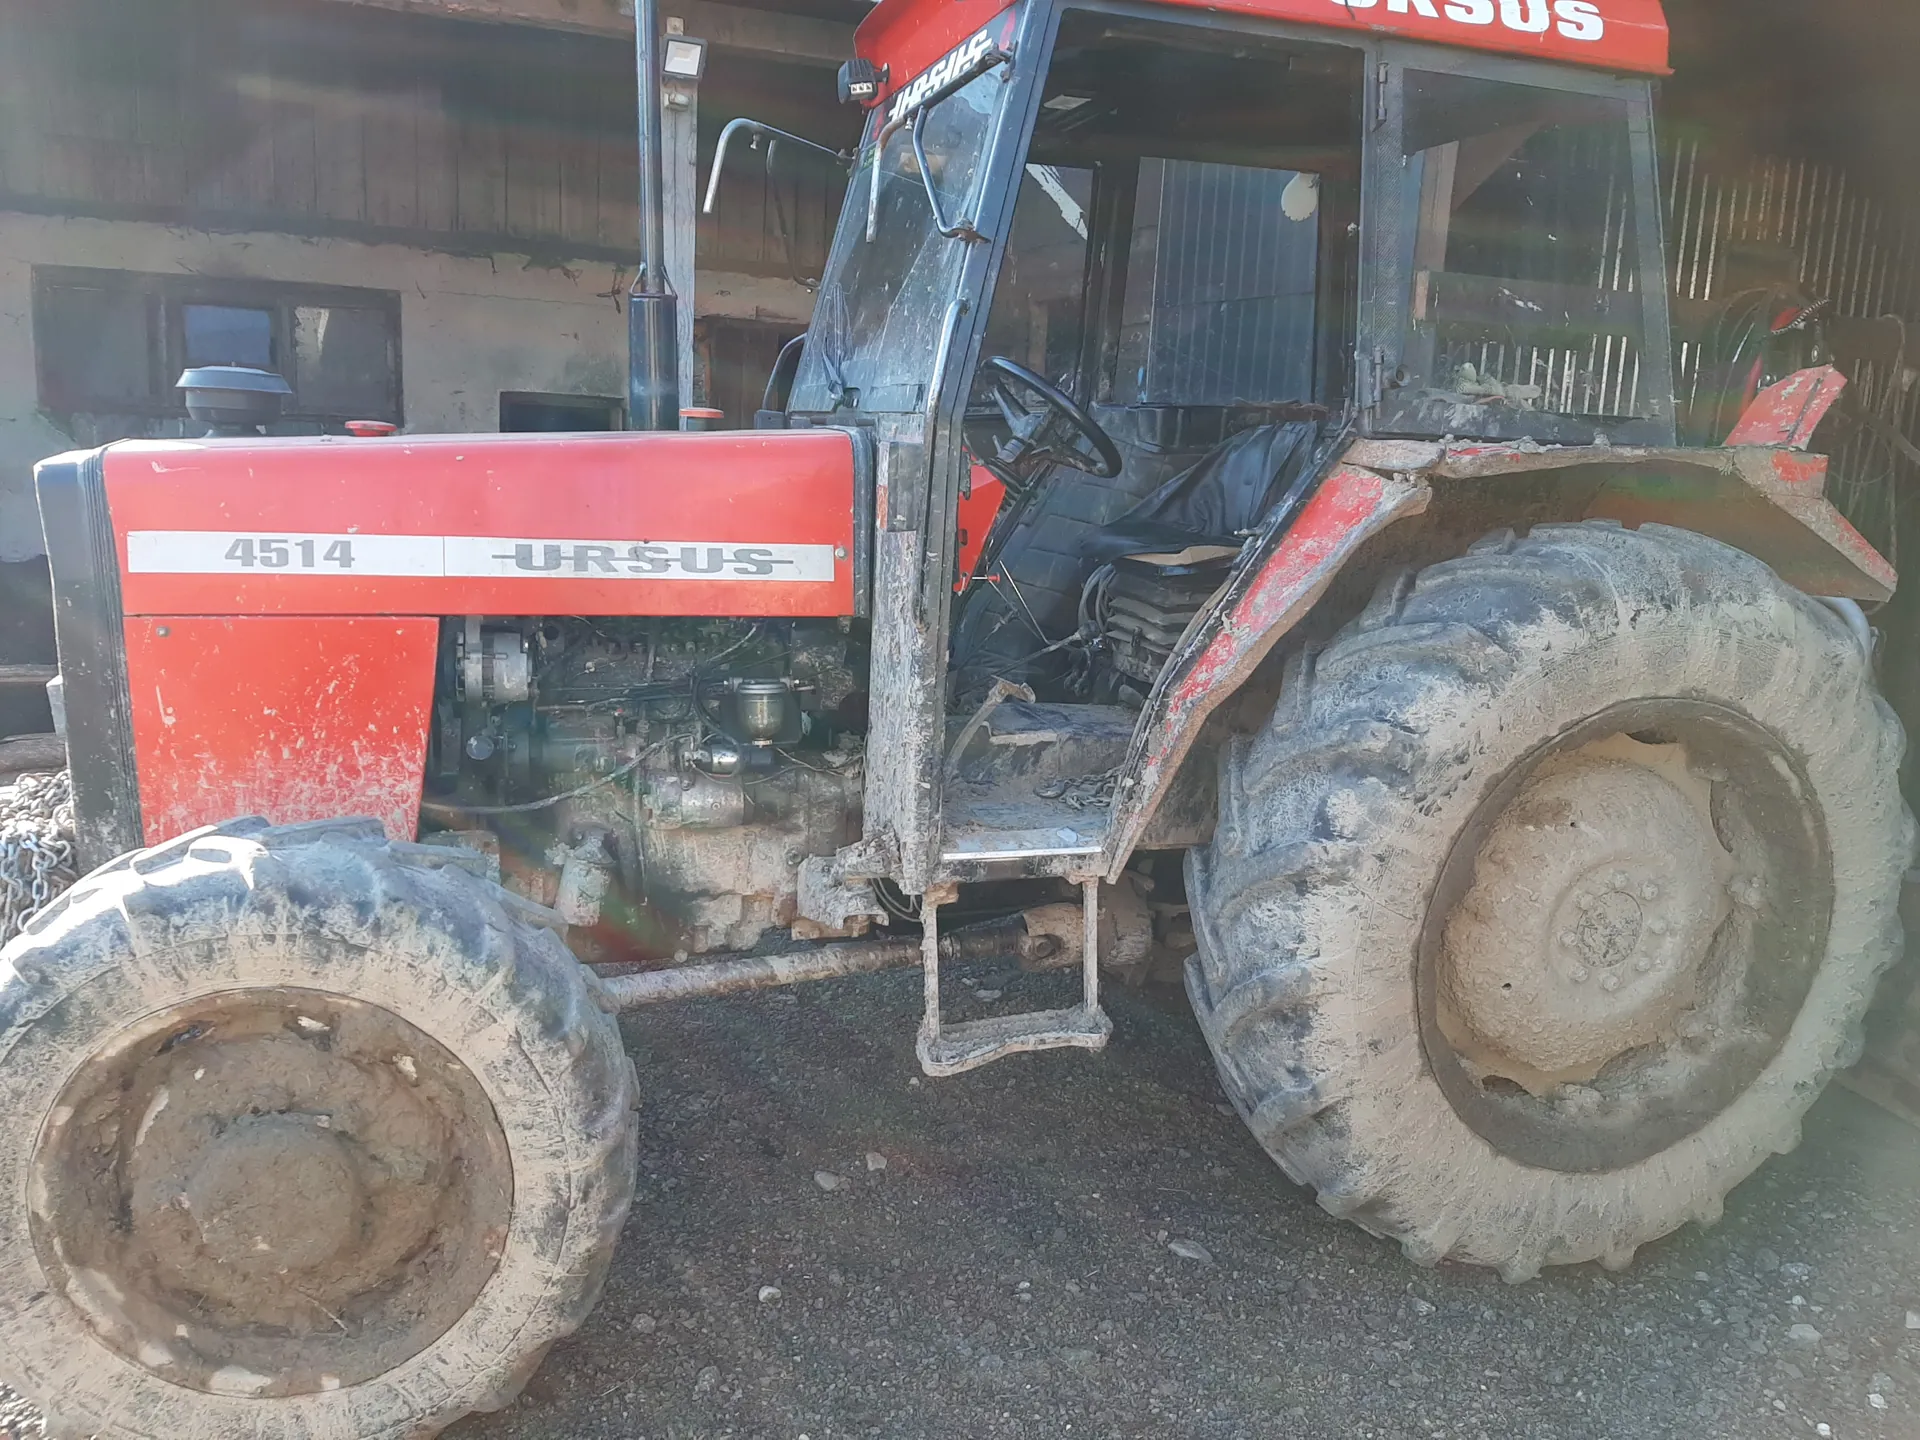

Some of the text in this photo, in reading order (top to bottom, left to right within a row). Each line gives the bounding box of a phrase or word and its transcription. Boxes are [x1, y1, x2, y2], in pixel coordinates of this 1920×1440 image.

[1329, 0, 1604, 41] SUS
[225, 538, 774, 575] 4514 URSUS
